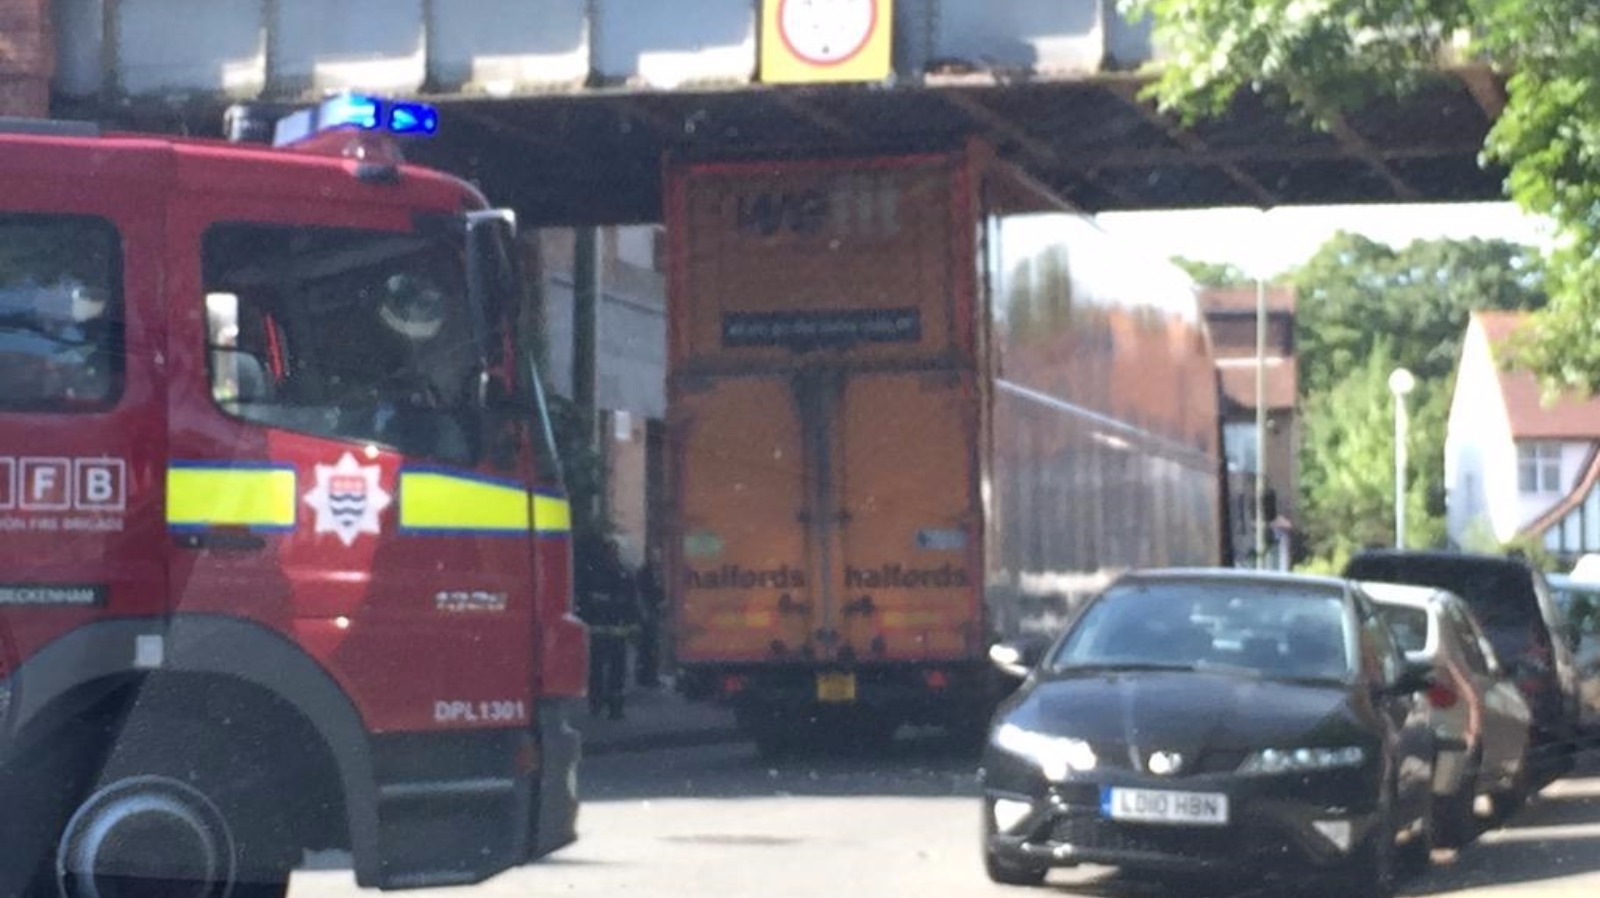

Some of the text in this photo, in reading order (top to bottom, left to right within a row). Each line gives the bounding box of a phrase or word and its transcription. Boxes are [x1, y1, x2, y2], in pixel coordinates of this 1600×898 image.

[34, 466, 113, 501] F B
[684, 562, 969, 589] halfords halfords
[434, 700, 524, 721] DPL1301
[1174, 794, 1218, 817] HBN
